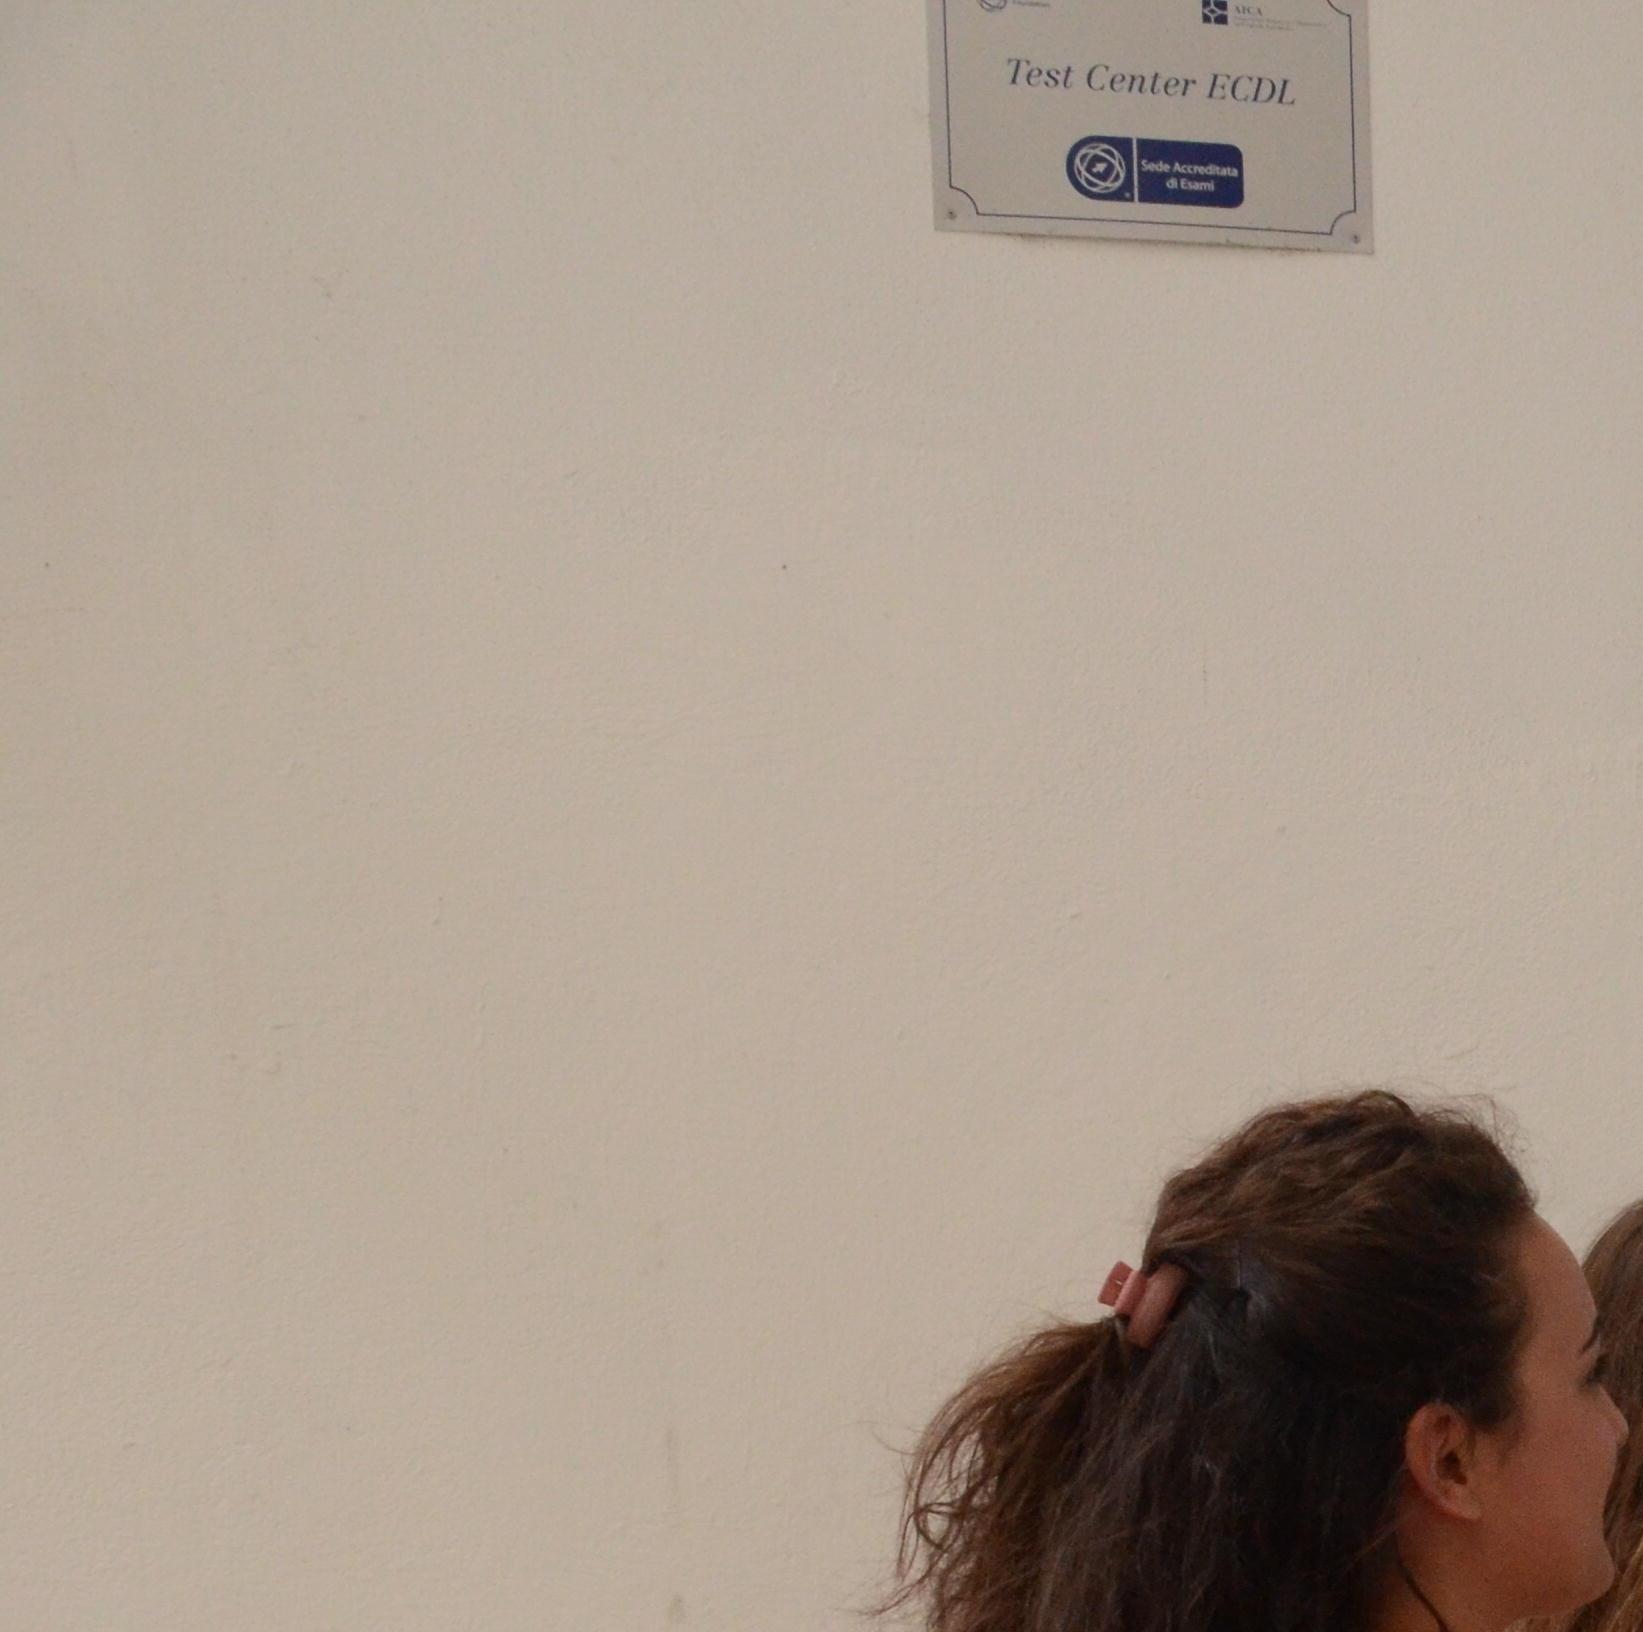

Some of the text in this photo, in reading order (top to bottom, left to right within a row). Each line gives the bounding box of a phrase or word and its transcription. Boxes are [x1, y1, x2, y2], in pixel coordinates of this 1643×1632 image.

[1007, 58, 1297, 106] Test Center ECDL
[1141, 159, 1239, 179] Sede Accreditata
[1166, 176, 1215, 193] di Esami
